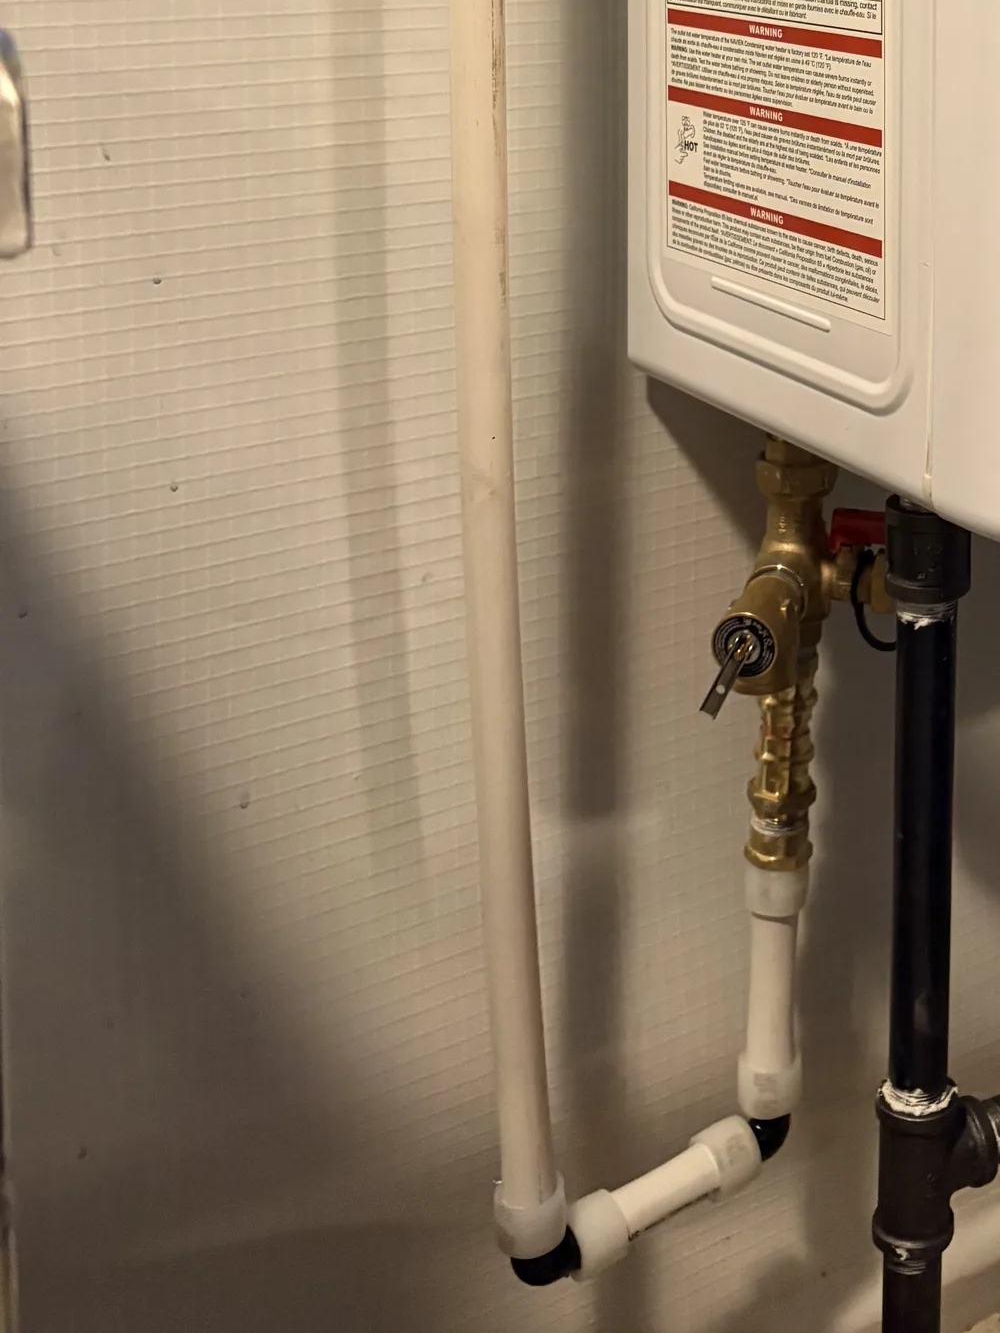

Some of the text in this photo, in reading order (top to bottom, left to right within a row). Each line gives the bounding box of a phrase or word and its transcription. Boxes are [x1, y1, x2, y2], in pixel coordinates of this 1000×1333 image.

[749, 25, 783, 38] WARNING
[750, 106, 783, 122] WARNING
[684, 140, 698, 153] HOT
[750, 207, 784, 225] WARNING
